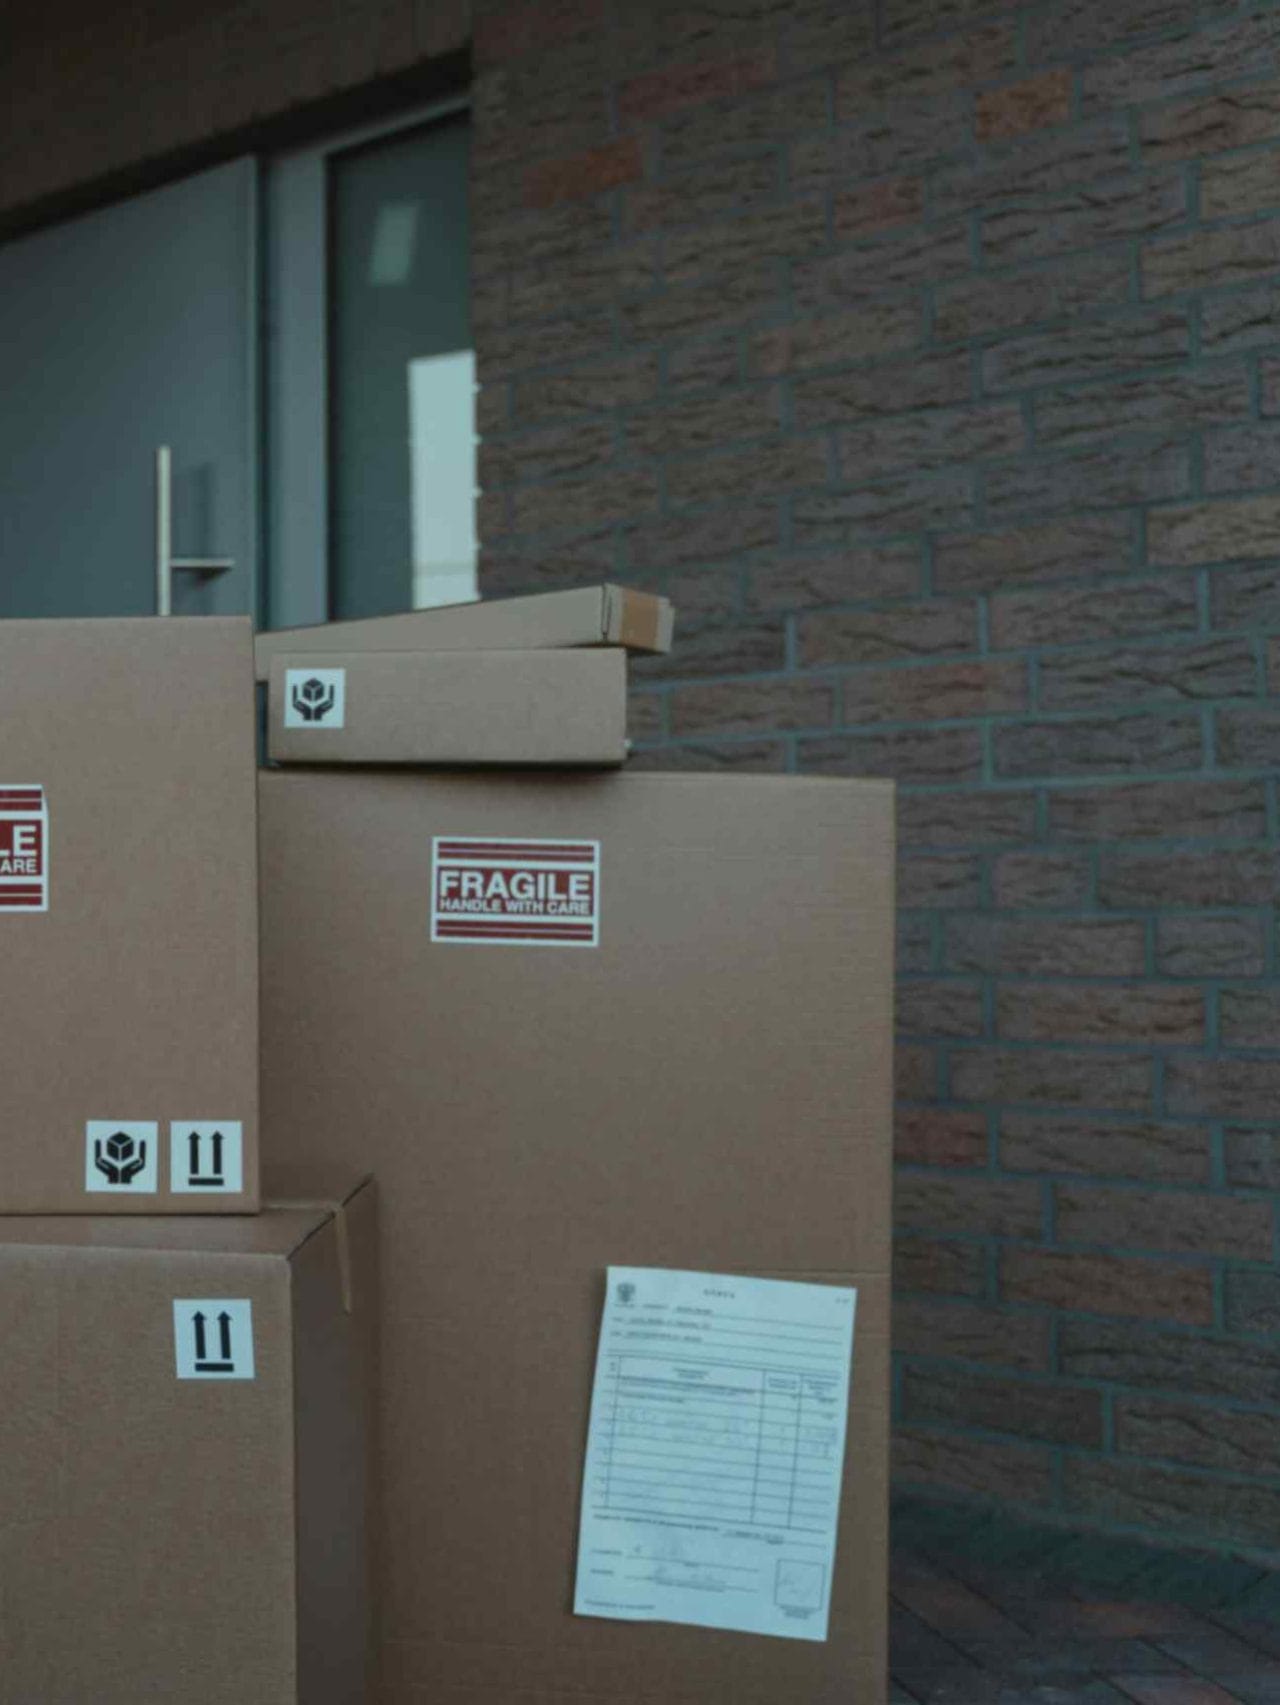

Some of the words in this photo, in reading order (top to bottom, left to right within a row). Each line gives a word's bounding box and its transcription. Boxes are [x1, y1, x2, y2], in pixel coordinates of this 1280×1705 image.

[440, 870, 590, 901] FRAGILE
[440, 898, 502, 912] HANDLE
[505, 900, 543, 914] WITH
[547, 901, 589, 915] CARE
